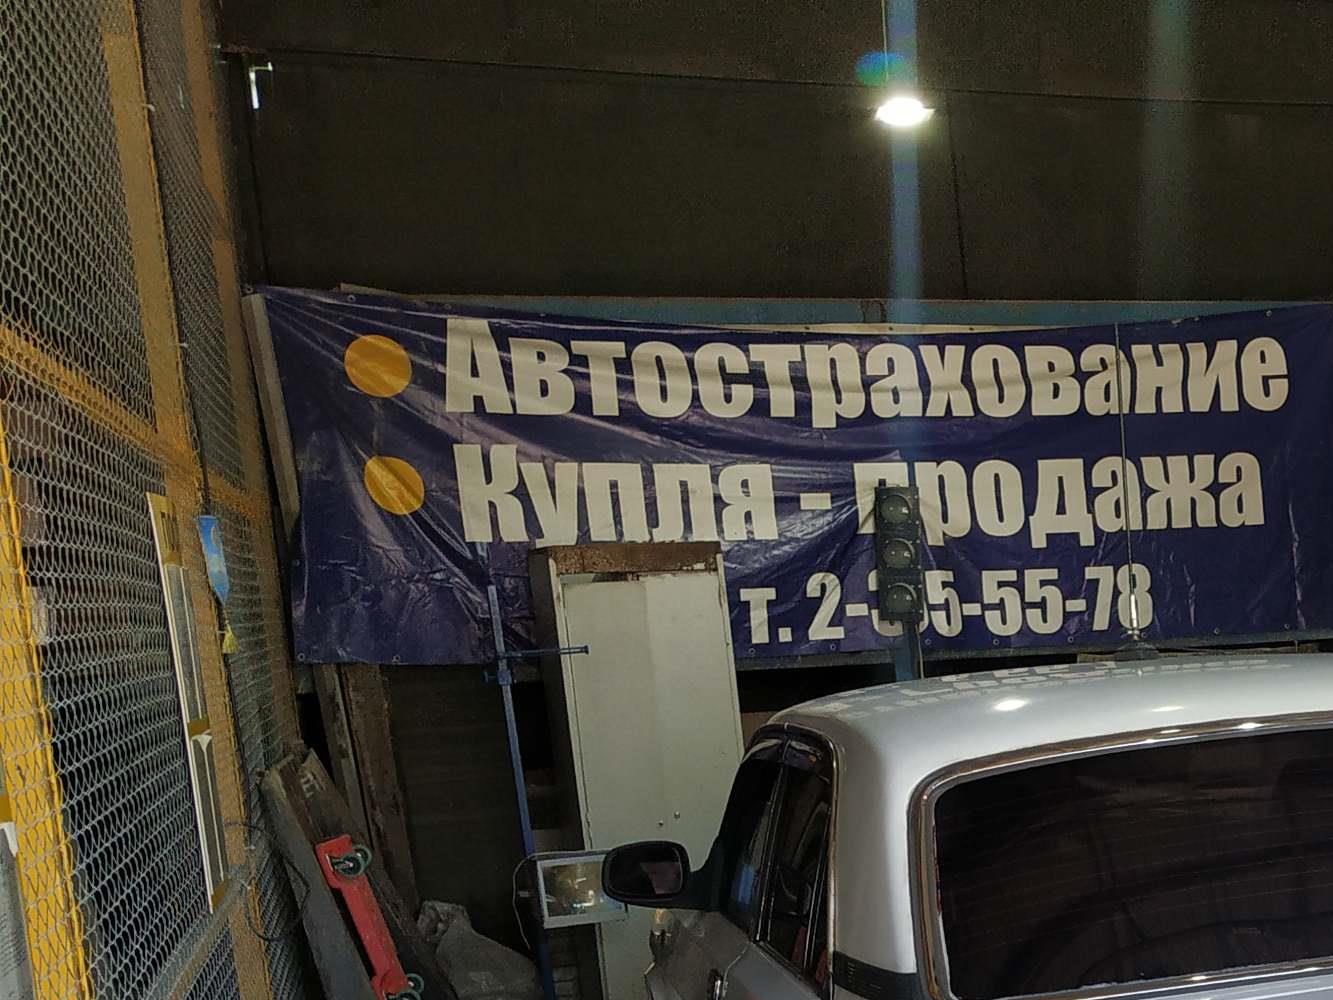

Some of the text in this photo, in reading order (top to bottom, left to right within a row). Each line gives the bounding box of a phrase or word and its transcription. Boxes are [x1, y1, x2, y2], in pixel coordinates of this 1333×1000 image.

[445, 317, 1289, 429] Автострахование
[452, 443, 778, 547] Купля
[853, 451, 1265, 549] продажа
